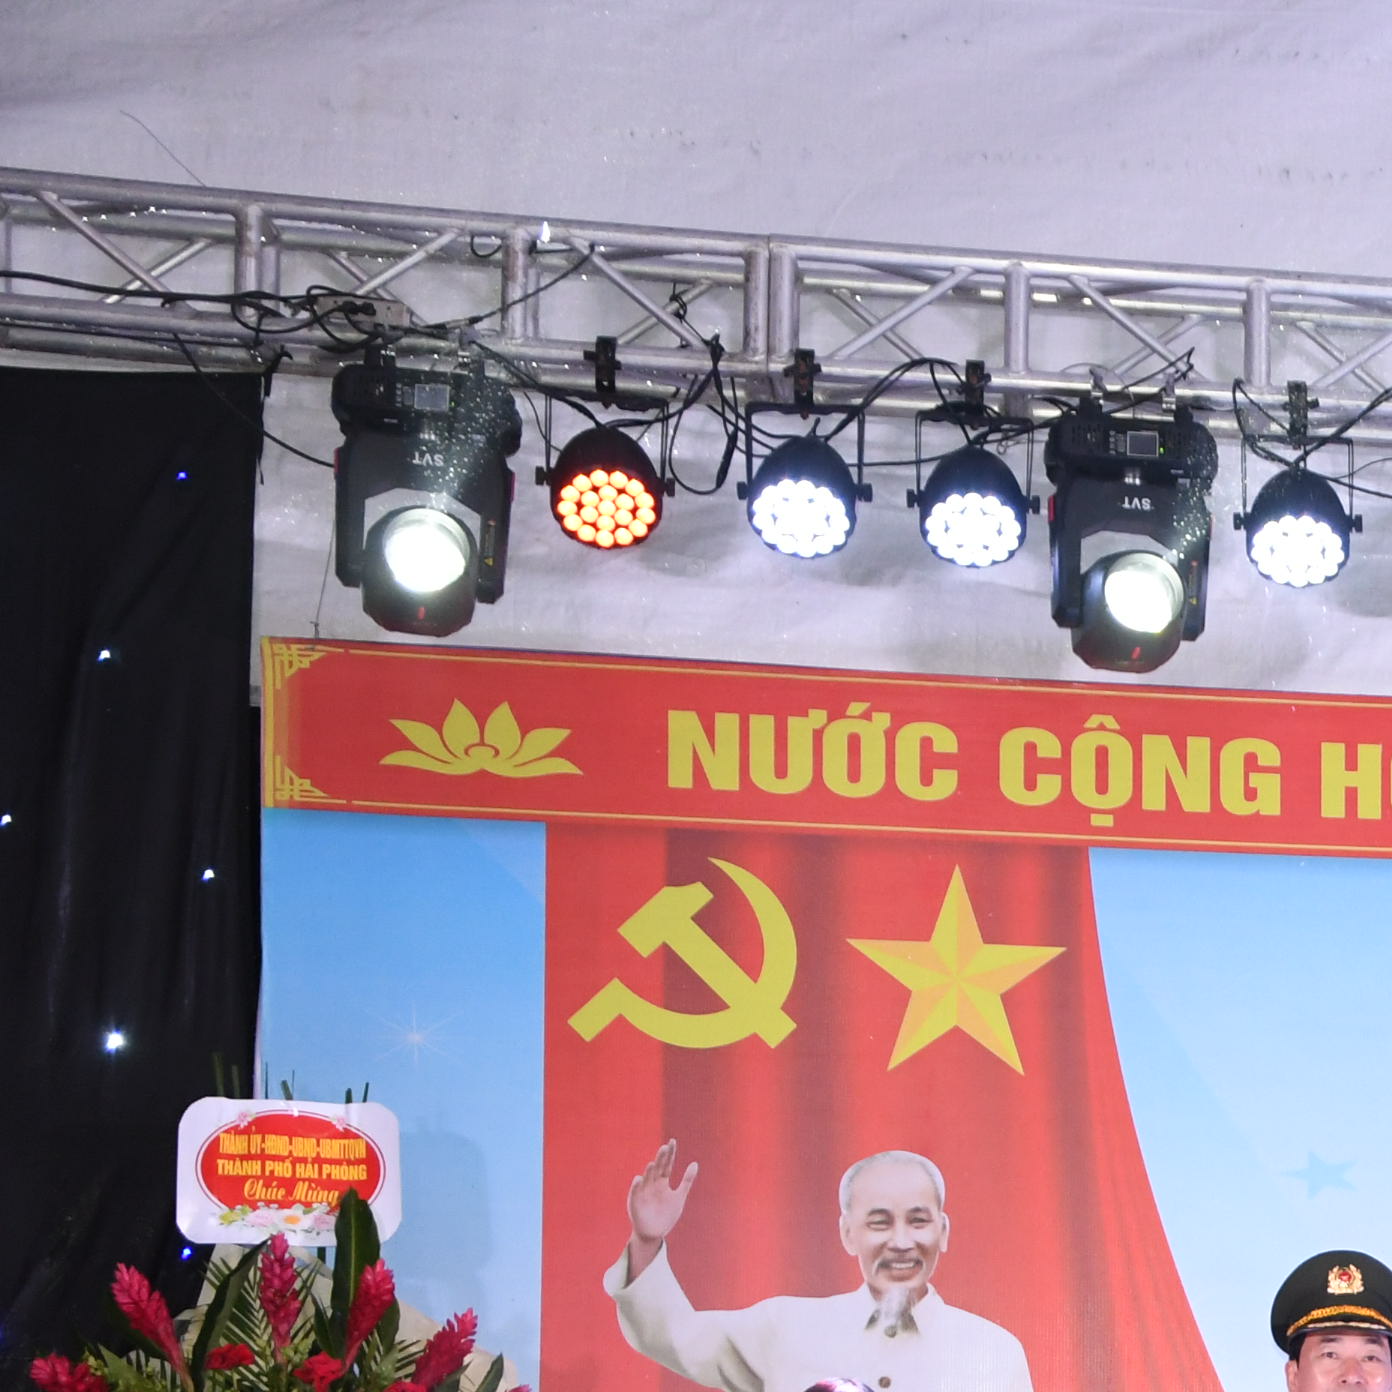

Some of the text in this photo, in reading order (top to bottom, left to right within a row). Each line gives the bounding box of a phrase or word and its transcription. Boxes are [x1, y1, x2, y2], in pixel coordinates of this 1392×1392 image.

[412, 453, 444, 467] SVT
[1121, 496, 1152, 511] SVT
[668, 702, 959, 803] NƯỚC
[1001, 714, 1282, 830] CỘNG
[216, 1157, 368, 1181] THÀNH PHỐ HẢI PHÒNG
[243, 1178, 340, 1207] Chúc Mừng
